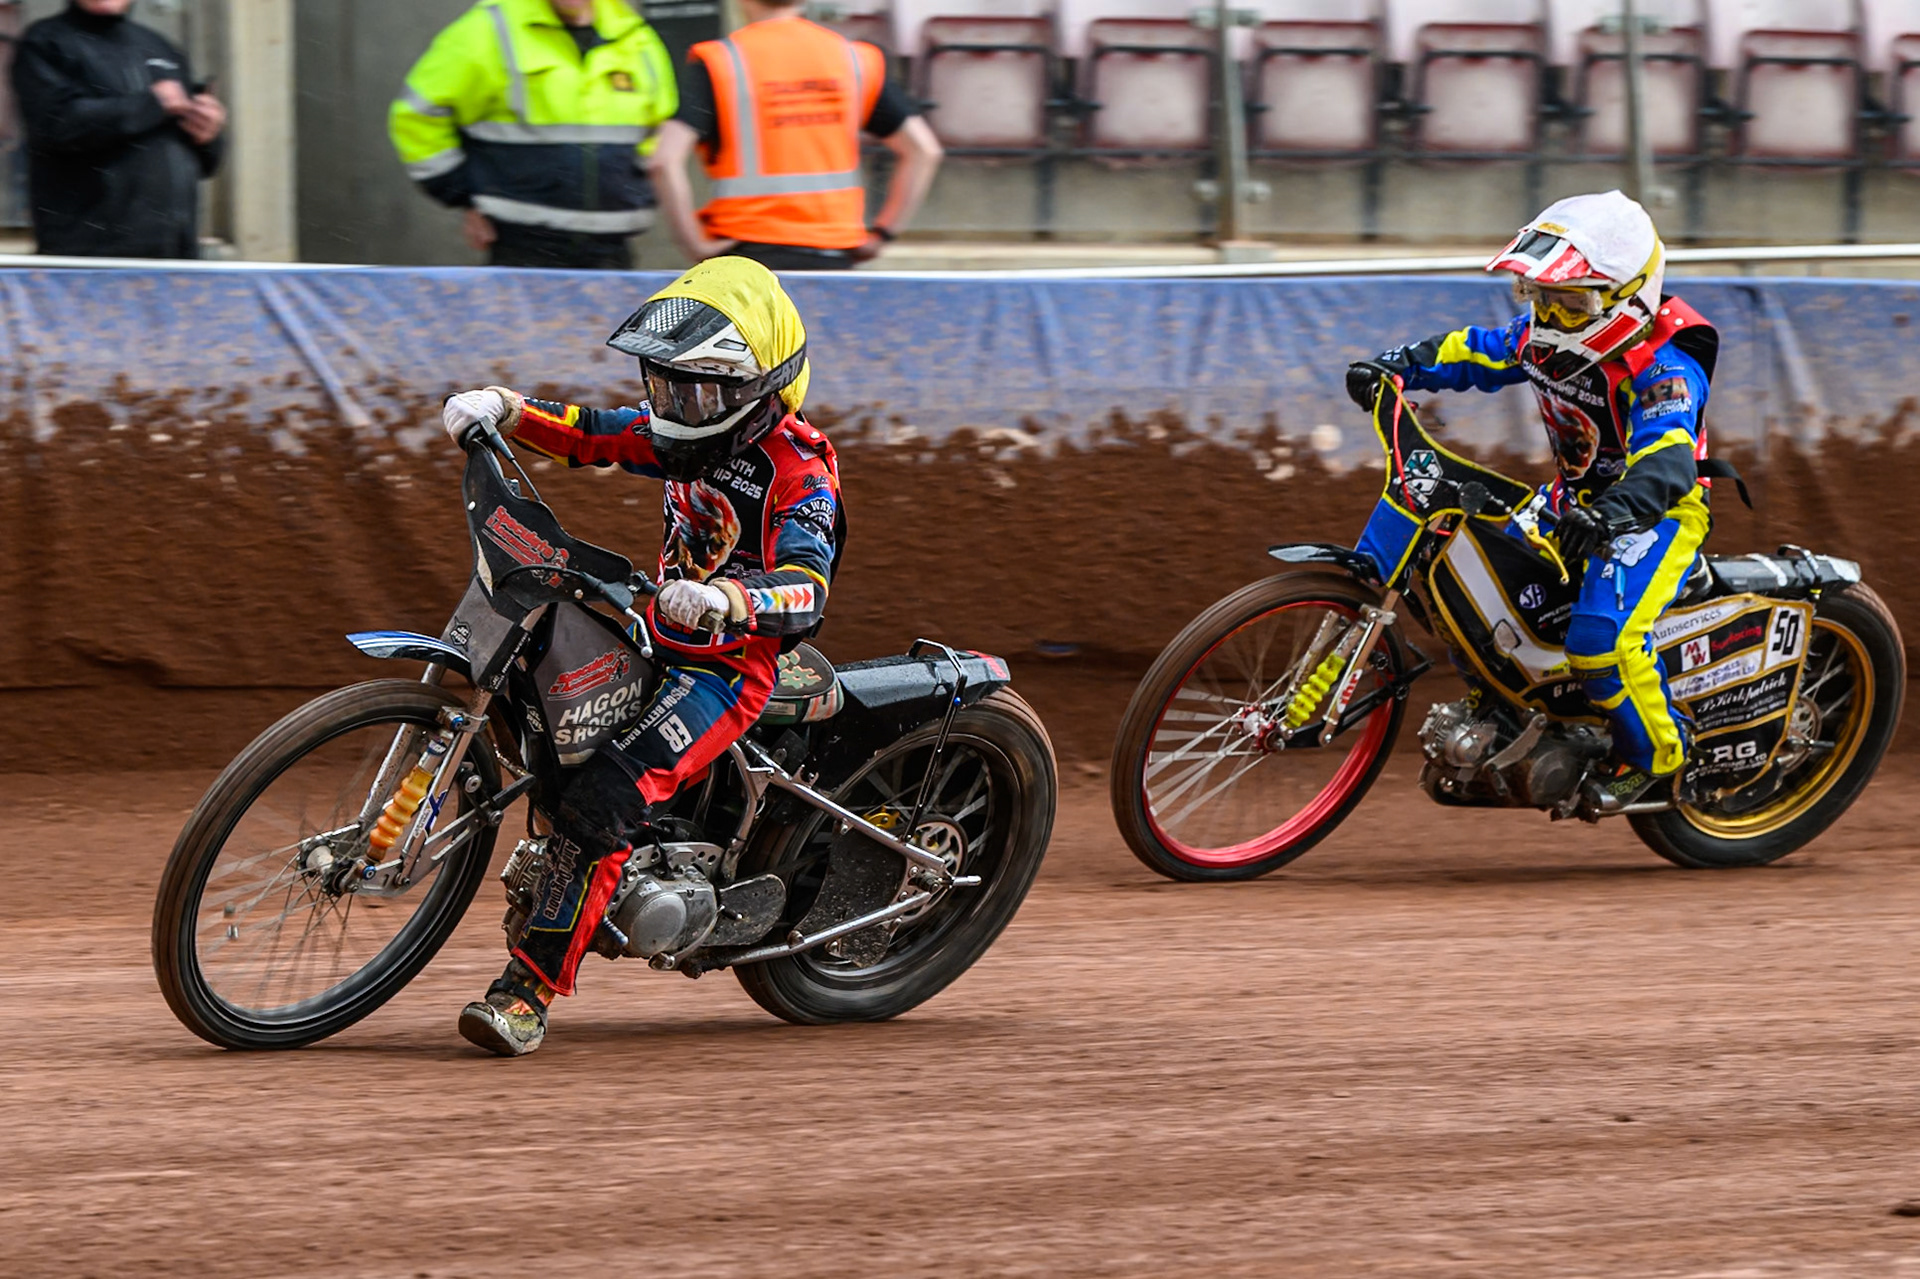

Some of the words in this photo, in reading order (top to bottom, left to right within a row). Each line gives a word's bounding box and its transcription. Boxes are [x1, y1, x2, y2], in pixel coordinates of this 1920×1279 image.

[1578, 389, 1606, 407] 2025
[730, 458, 757, 478] UTH
[730, 476, 763, 500] 2025
[1772, 610, 1799, 656] 50
[558, 678, 642, 727] HAGON
[554, 700, 641, 745] SHOCKS
[640, 706, 667, 731] BETTY
[1713, 741, 1757, 763] RG
